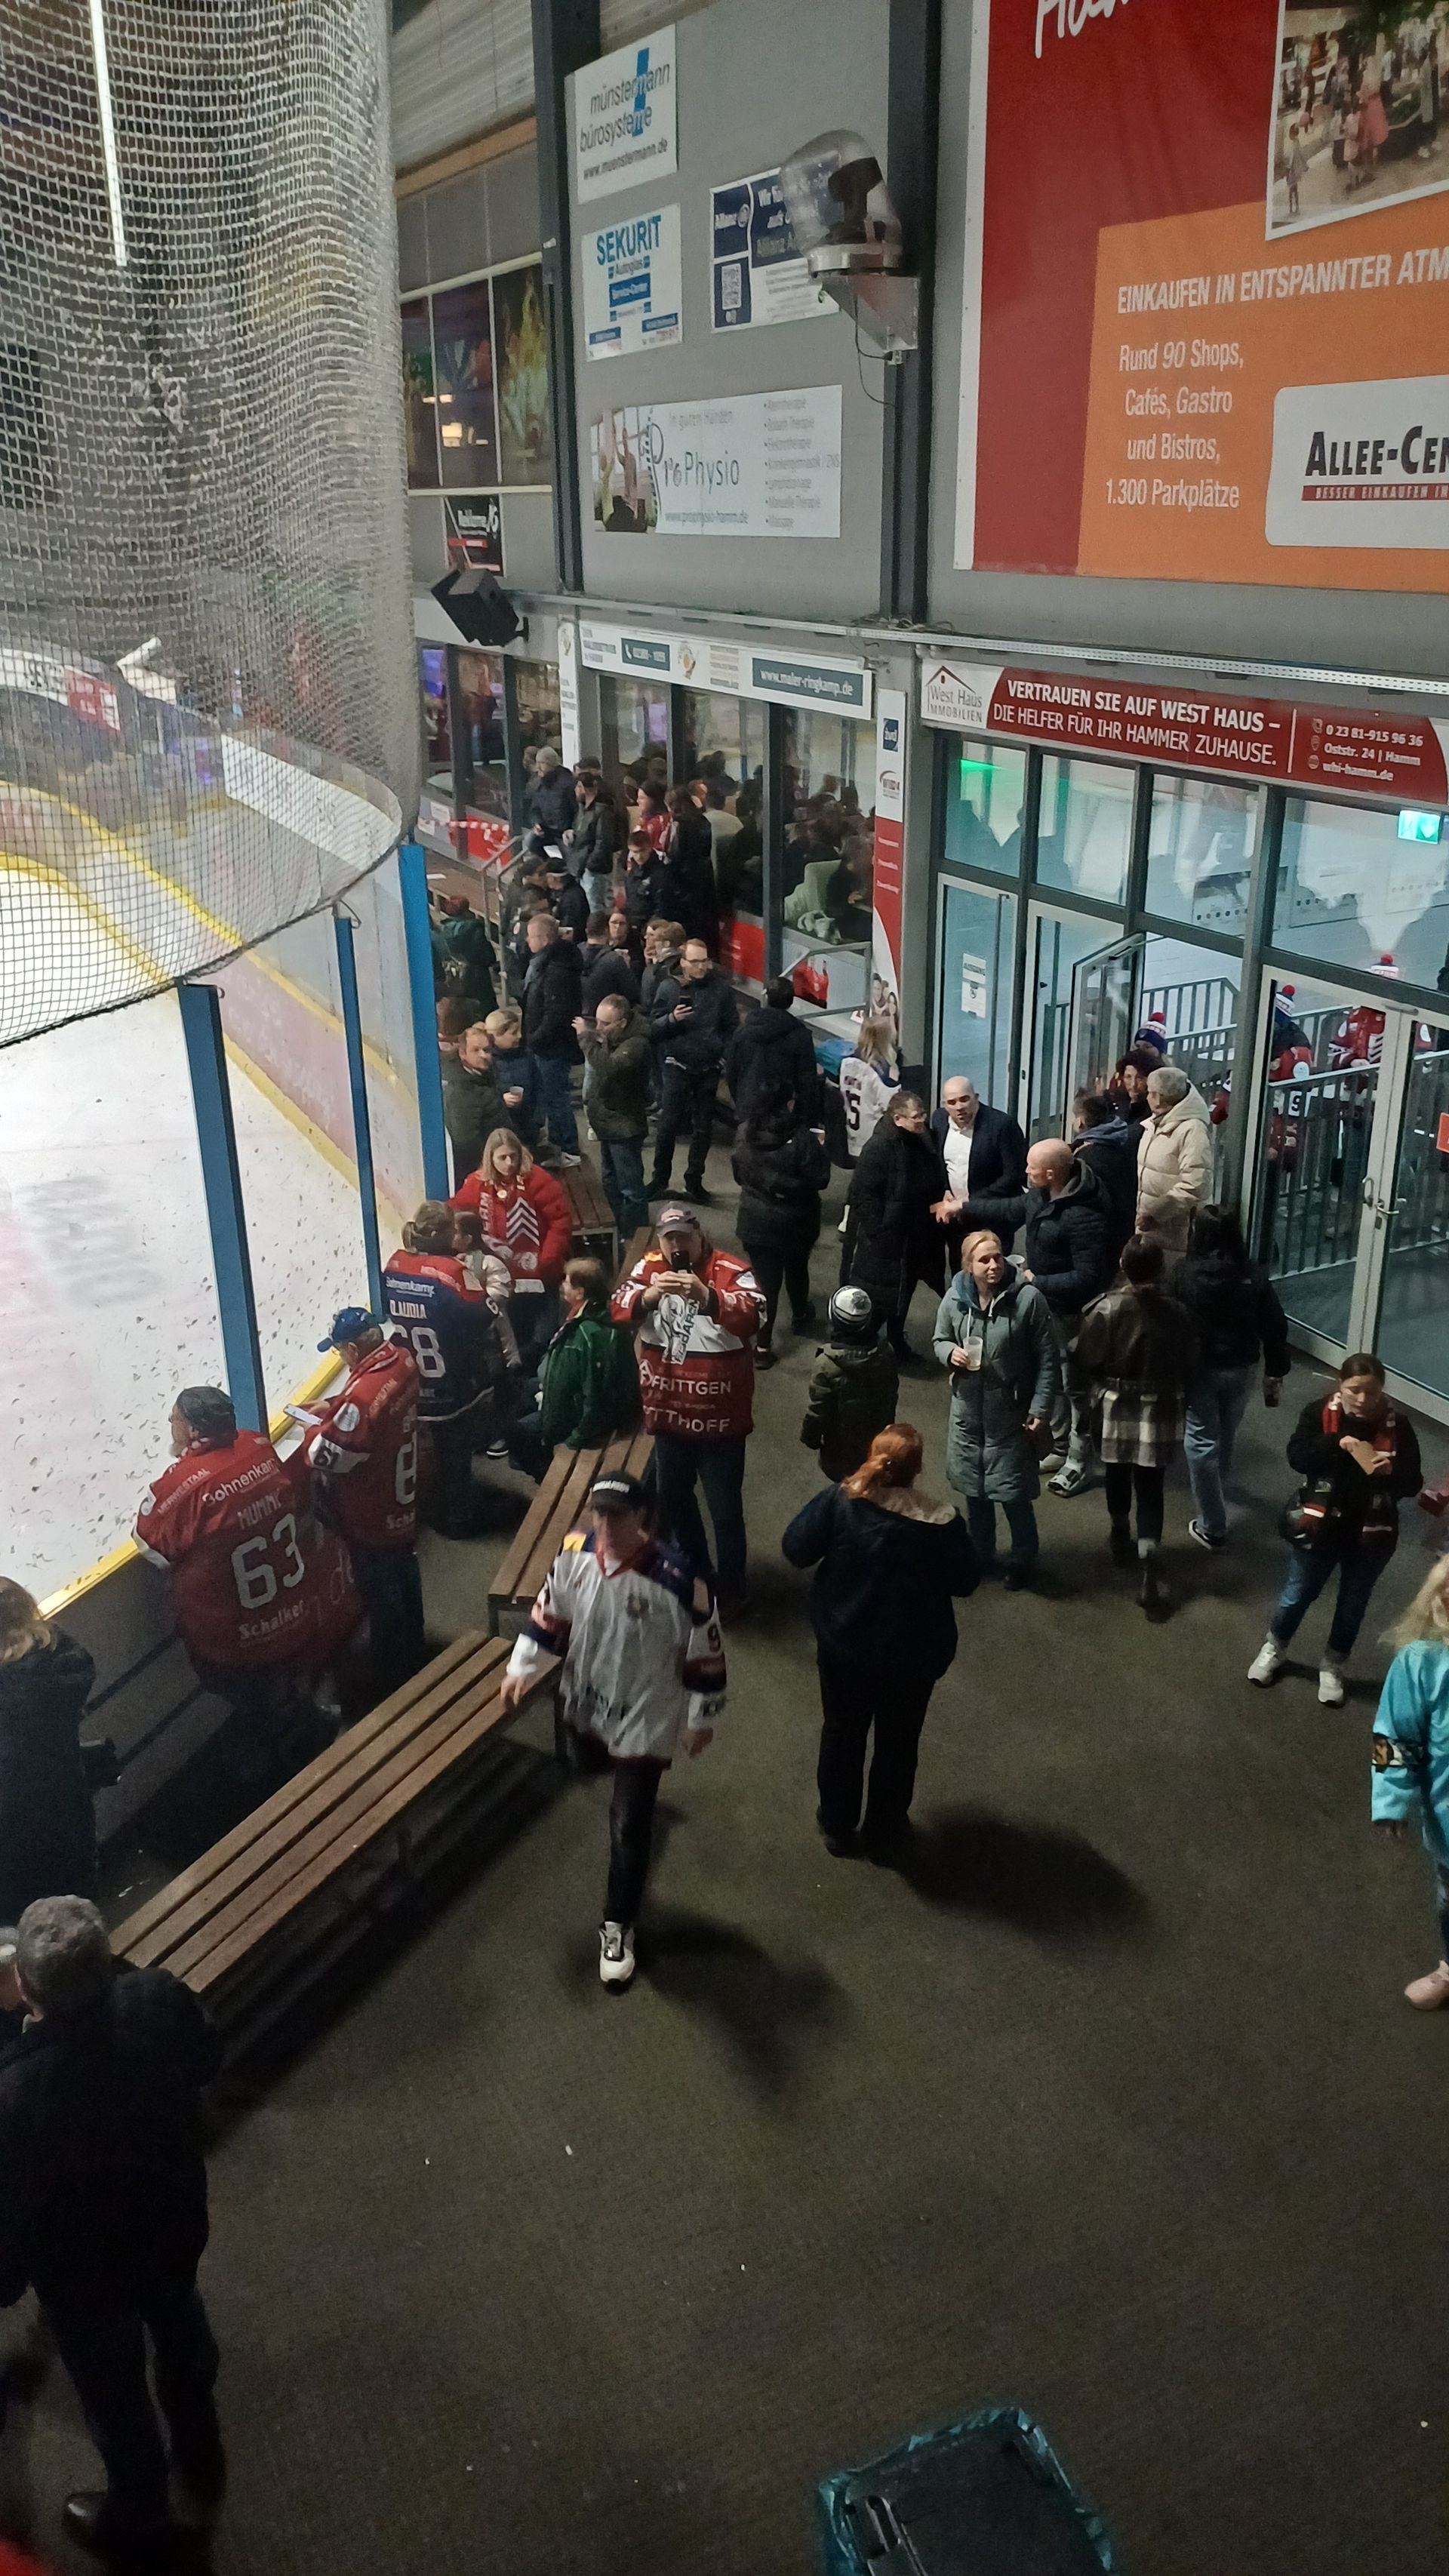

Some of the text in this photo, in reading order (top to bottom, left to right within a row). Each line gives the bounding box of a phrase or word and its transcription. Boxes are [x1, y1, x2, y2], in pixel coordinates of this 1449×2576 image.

[596, 215, 662, 266] SEKURIT
[1117, 276, 1209, 314] EINKAUFEN
[1215, 274, 1235, 304] IN
[1240, 254, 1392, 302] ENTSPANNTER
[1119, 339, 1244, 371] Rund 90 Shops,
[1125, 386, 1232, 418] Cafés, Gastro
[1127, 433, 1220, 464] und Bistros,
[1106, 479, 1241, 512] 1.300 Parkplätze
[1315, 486, 1356, 500] BESSER
[1361, 485, 1429, 499] EINKAUFEN
[930, 685, 983, 708] West Haus
[1008, 679, 1091, 708] VERTRAUEN
[1094, 691, 1121, 712] SIE
[1124, 695, 1157, 717] AUF
[1161, 700, 1210, 725] WEST
[1214, 707, 1264, 733] HAUS
[994, 703, 1277, 766] DIE HELFER FÜR IHR HAMMER ZUHAUSE.
[1326, 725, 1334, 735] 0
[1335, 725, 1349, 737] 23
[1408, 734, 1423, 746] 36
[1361, 747, 1375, 759] 24
[651, 1375, 731, 1396] FRITTGEN
[231, 1513, 305, 1609] 63
